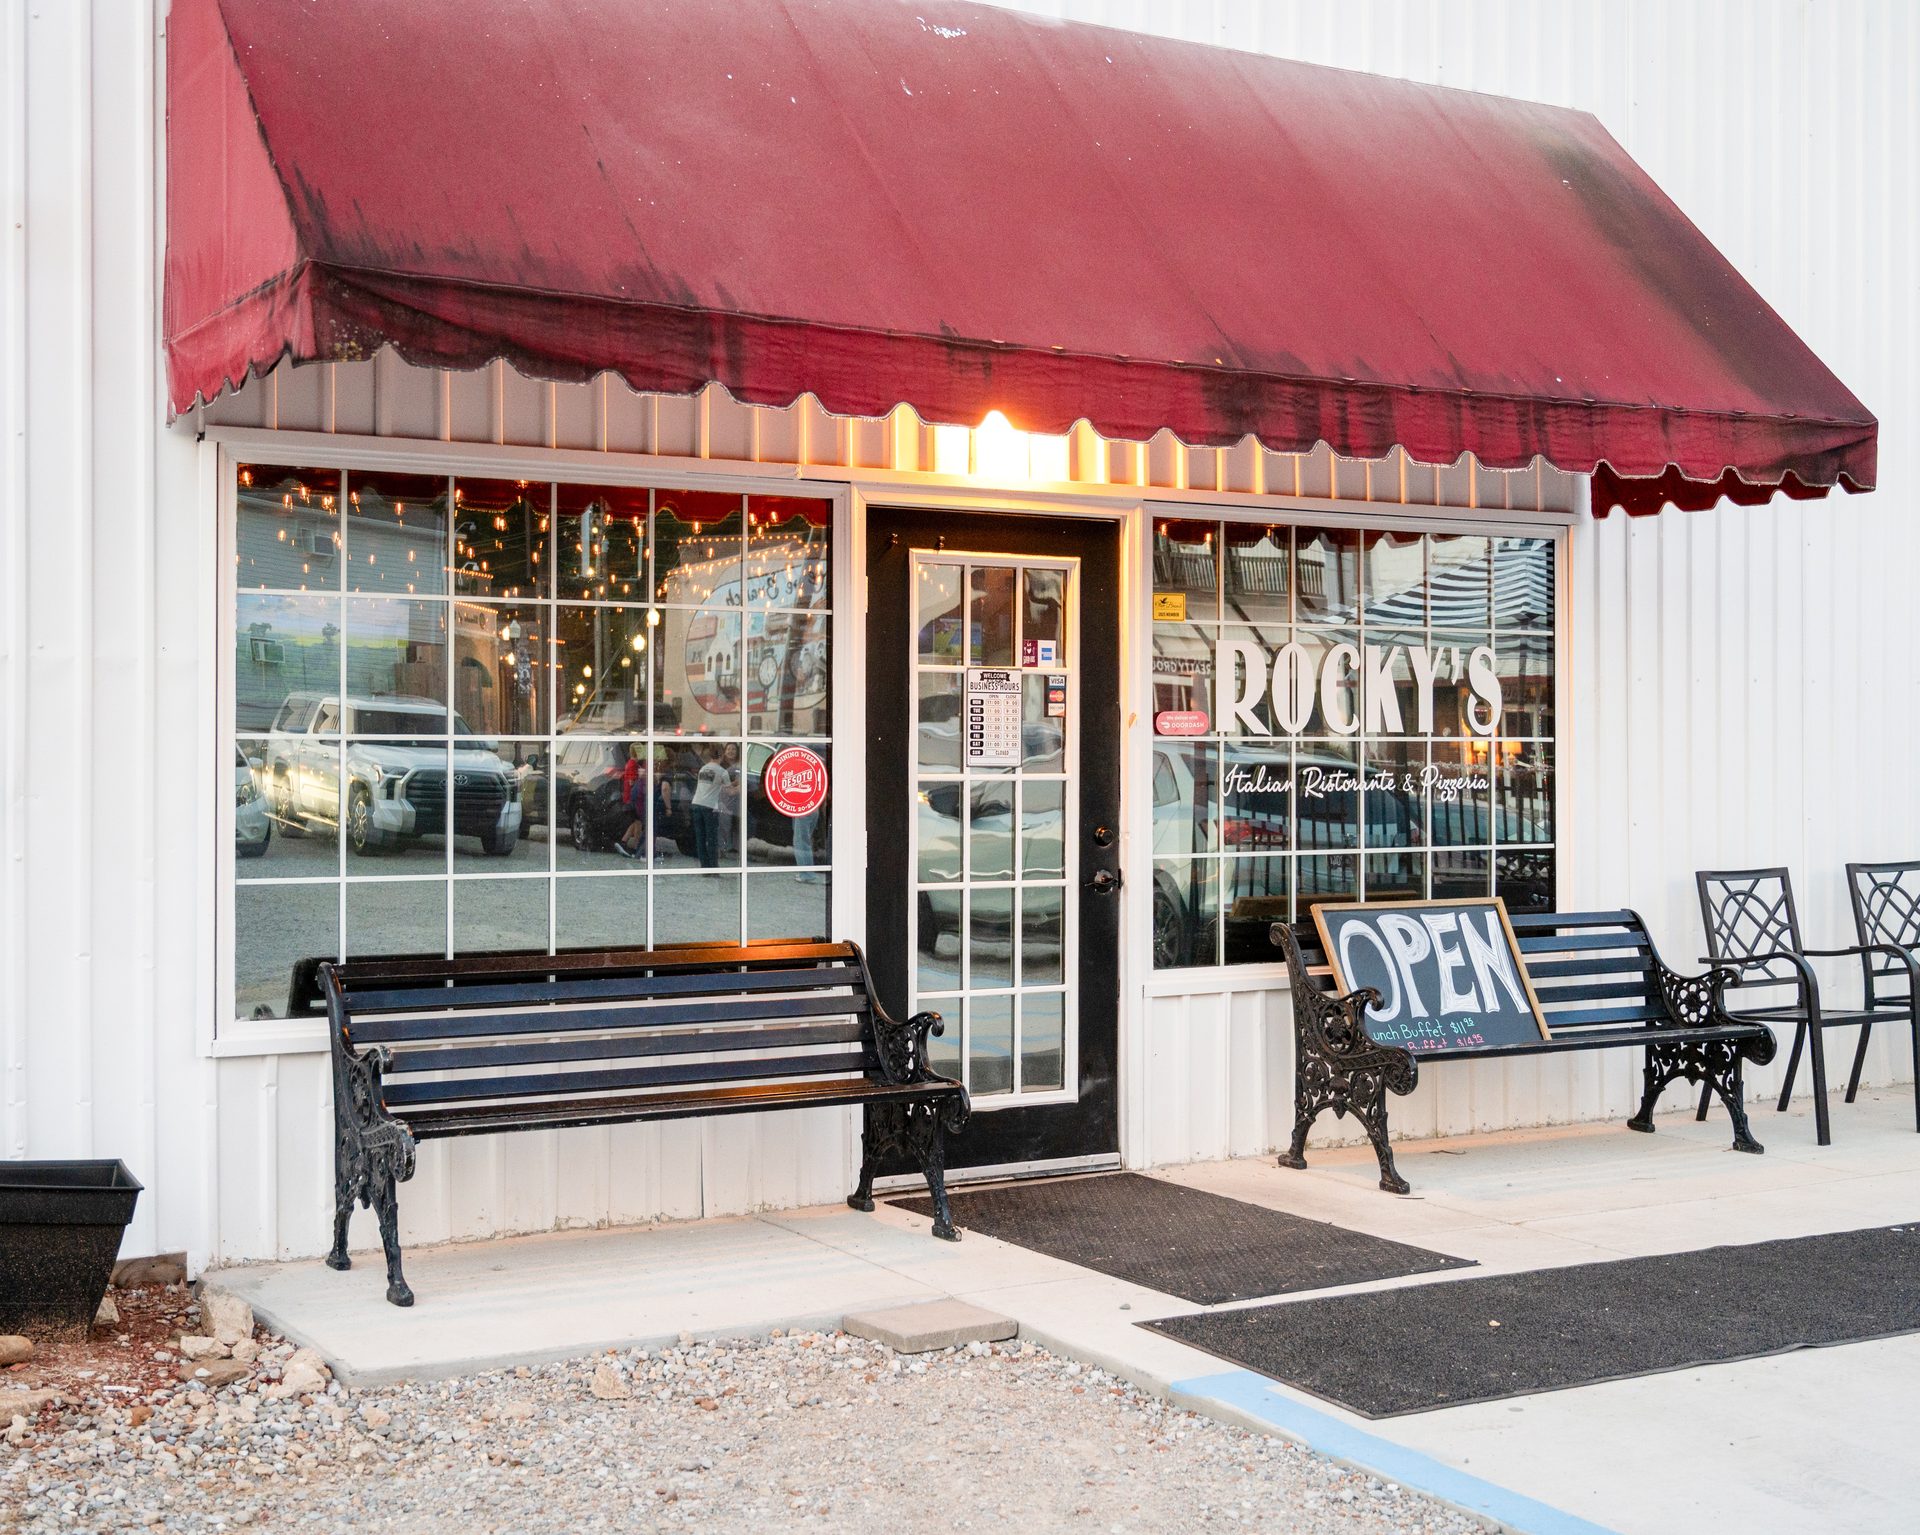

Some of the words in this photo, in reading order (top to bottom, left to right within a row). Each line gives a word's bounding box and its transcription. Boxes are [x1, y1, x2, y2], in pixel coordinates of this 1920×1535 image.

[970, 682, 998, 691] BUSINESS
[1000, 683, 1020, 691] HOURS
[1216, 640, 1502, 735] ROCKY'S
[776, 752, 799, 765] DINING
[800, 752, 818, 766] WEEK
[782, 770, 812, 788] DESOTO
[1220, 764, 1296, 797] Italian
[1302, 765, 1396, 798] Ristorante
[1403, 774, 1414, 794] &
[1420, 765, 1489, 802] Pizzeria
[778, 800, 796, 812] APRIL
[1339, 910, 1531, 1023] OPEN
[1372, 1024, 1399, 1041] unch
[1400, 1019, 1446, 1039] Buffet
